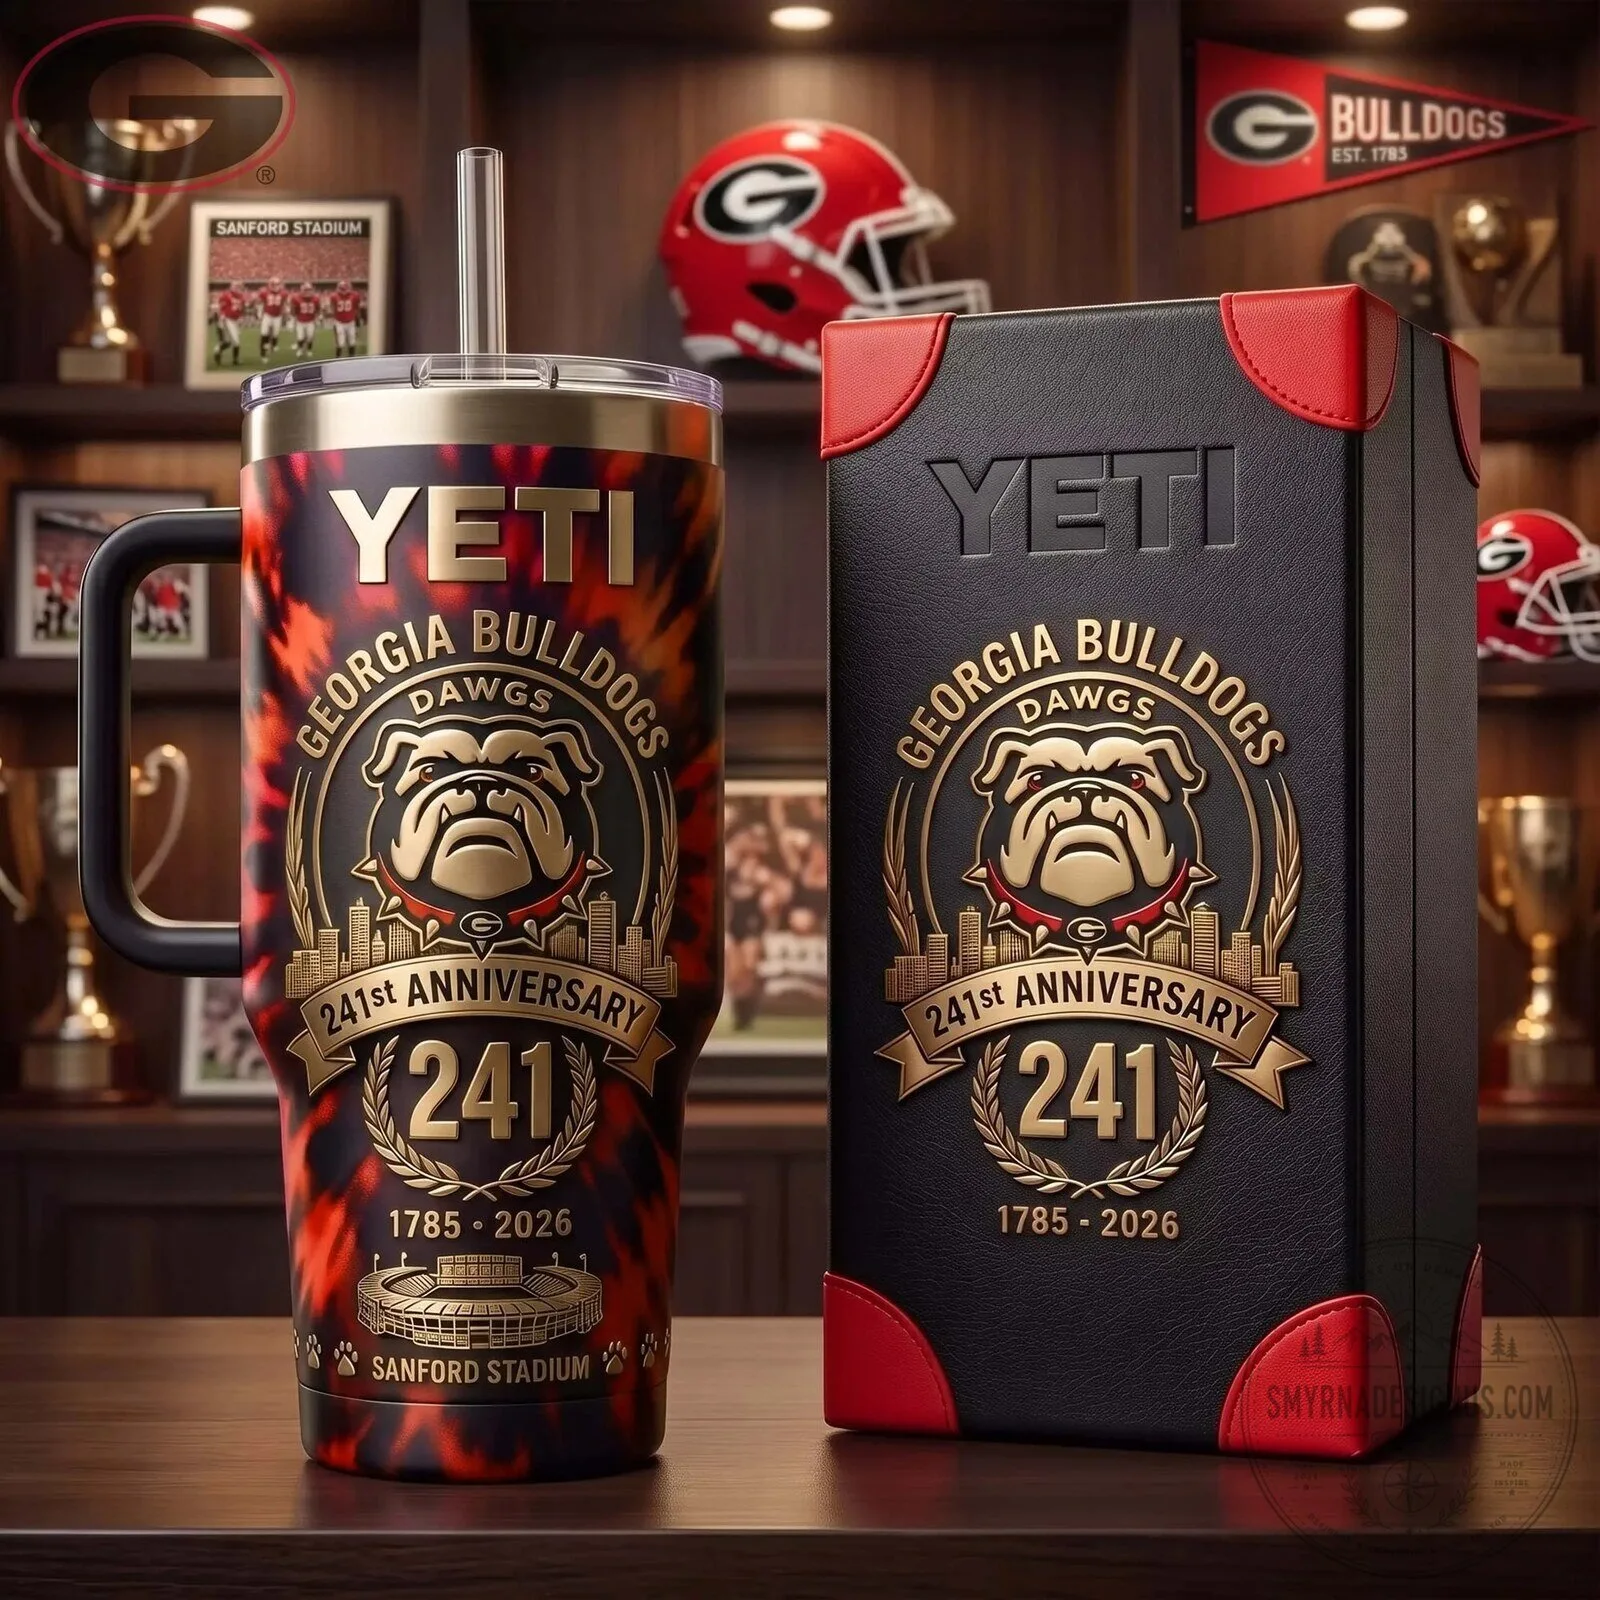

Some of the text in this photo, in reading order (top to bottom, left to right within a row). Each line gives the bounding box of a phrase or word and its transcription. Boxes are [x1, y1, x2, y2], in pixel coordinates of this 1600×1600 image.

[1330, 94, 1506, 143] BULLDOGS
[1332, 146, 1367, 164] EST.
[216, 221, 362, 236] SANFORD STADIUM
[922, 445, 1236, 559] YETI
[328, 486, 634, 586] YETI
[296, 609, 669, 760] GEORGIA BULLDOGS
[408, 676, 554, 717] DAWGS
[896, 618, 1286, 769] GEORGIA BULLDOGS
[1016, 685, 1156, 725] DAWGS
[319, 968, 646, 1036] 241st ANNIVERSARY
[925, 970, 1258, 1041] 241st ANNIVERSARY
[408, 1039, 552, 1140] 241
[1018, 1040, 1156, 1140] 241
[390, 1209, 461, 1239] 1785
[495, 1208, 573, 1239] 2026
[998, 1204, 1069, 1236] 1785
[1101, 1209, 1180, 1240] 2026
[372, 1354, 590, 1384] SANFORD STADIUM
